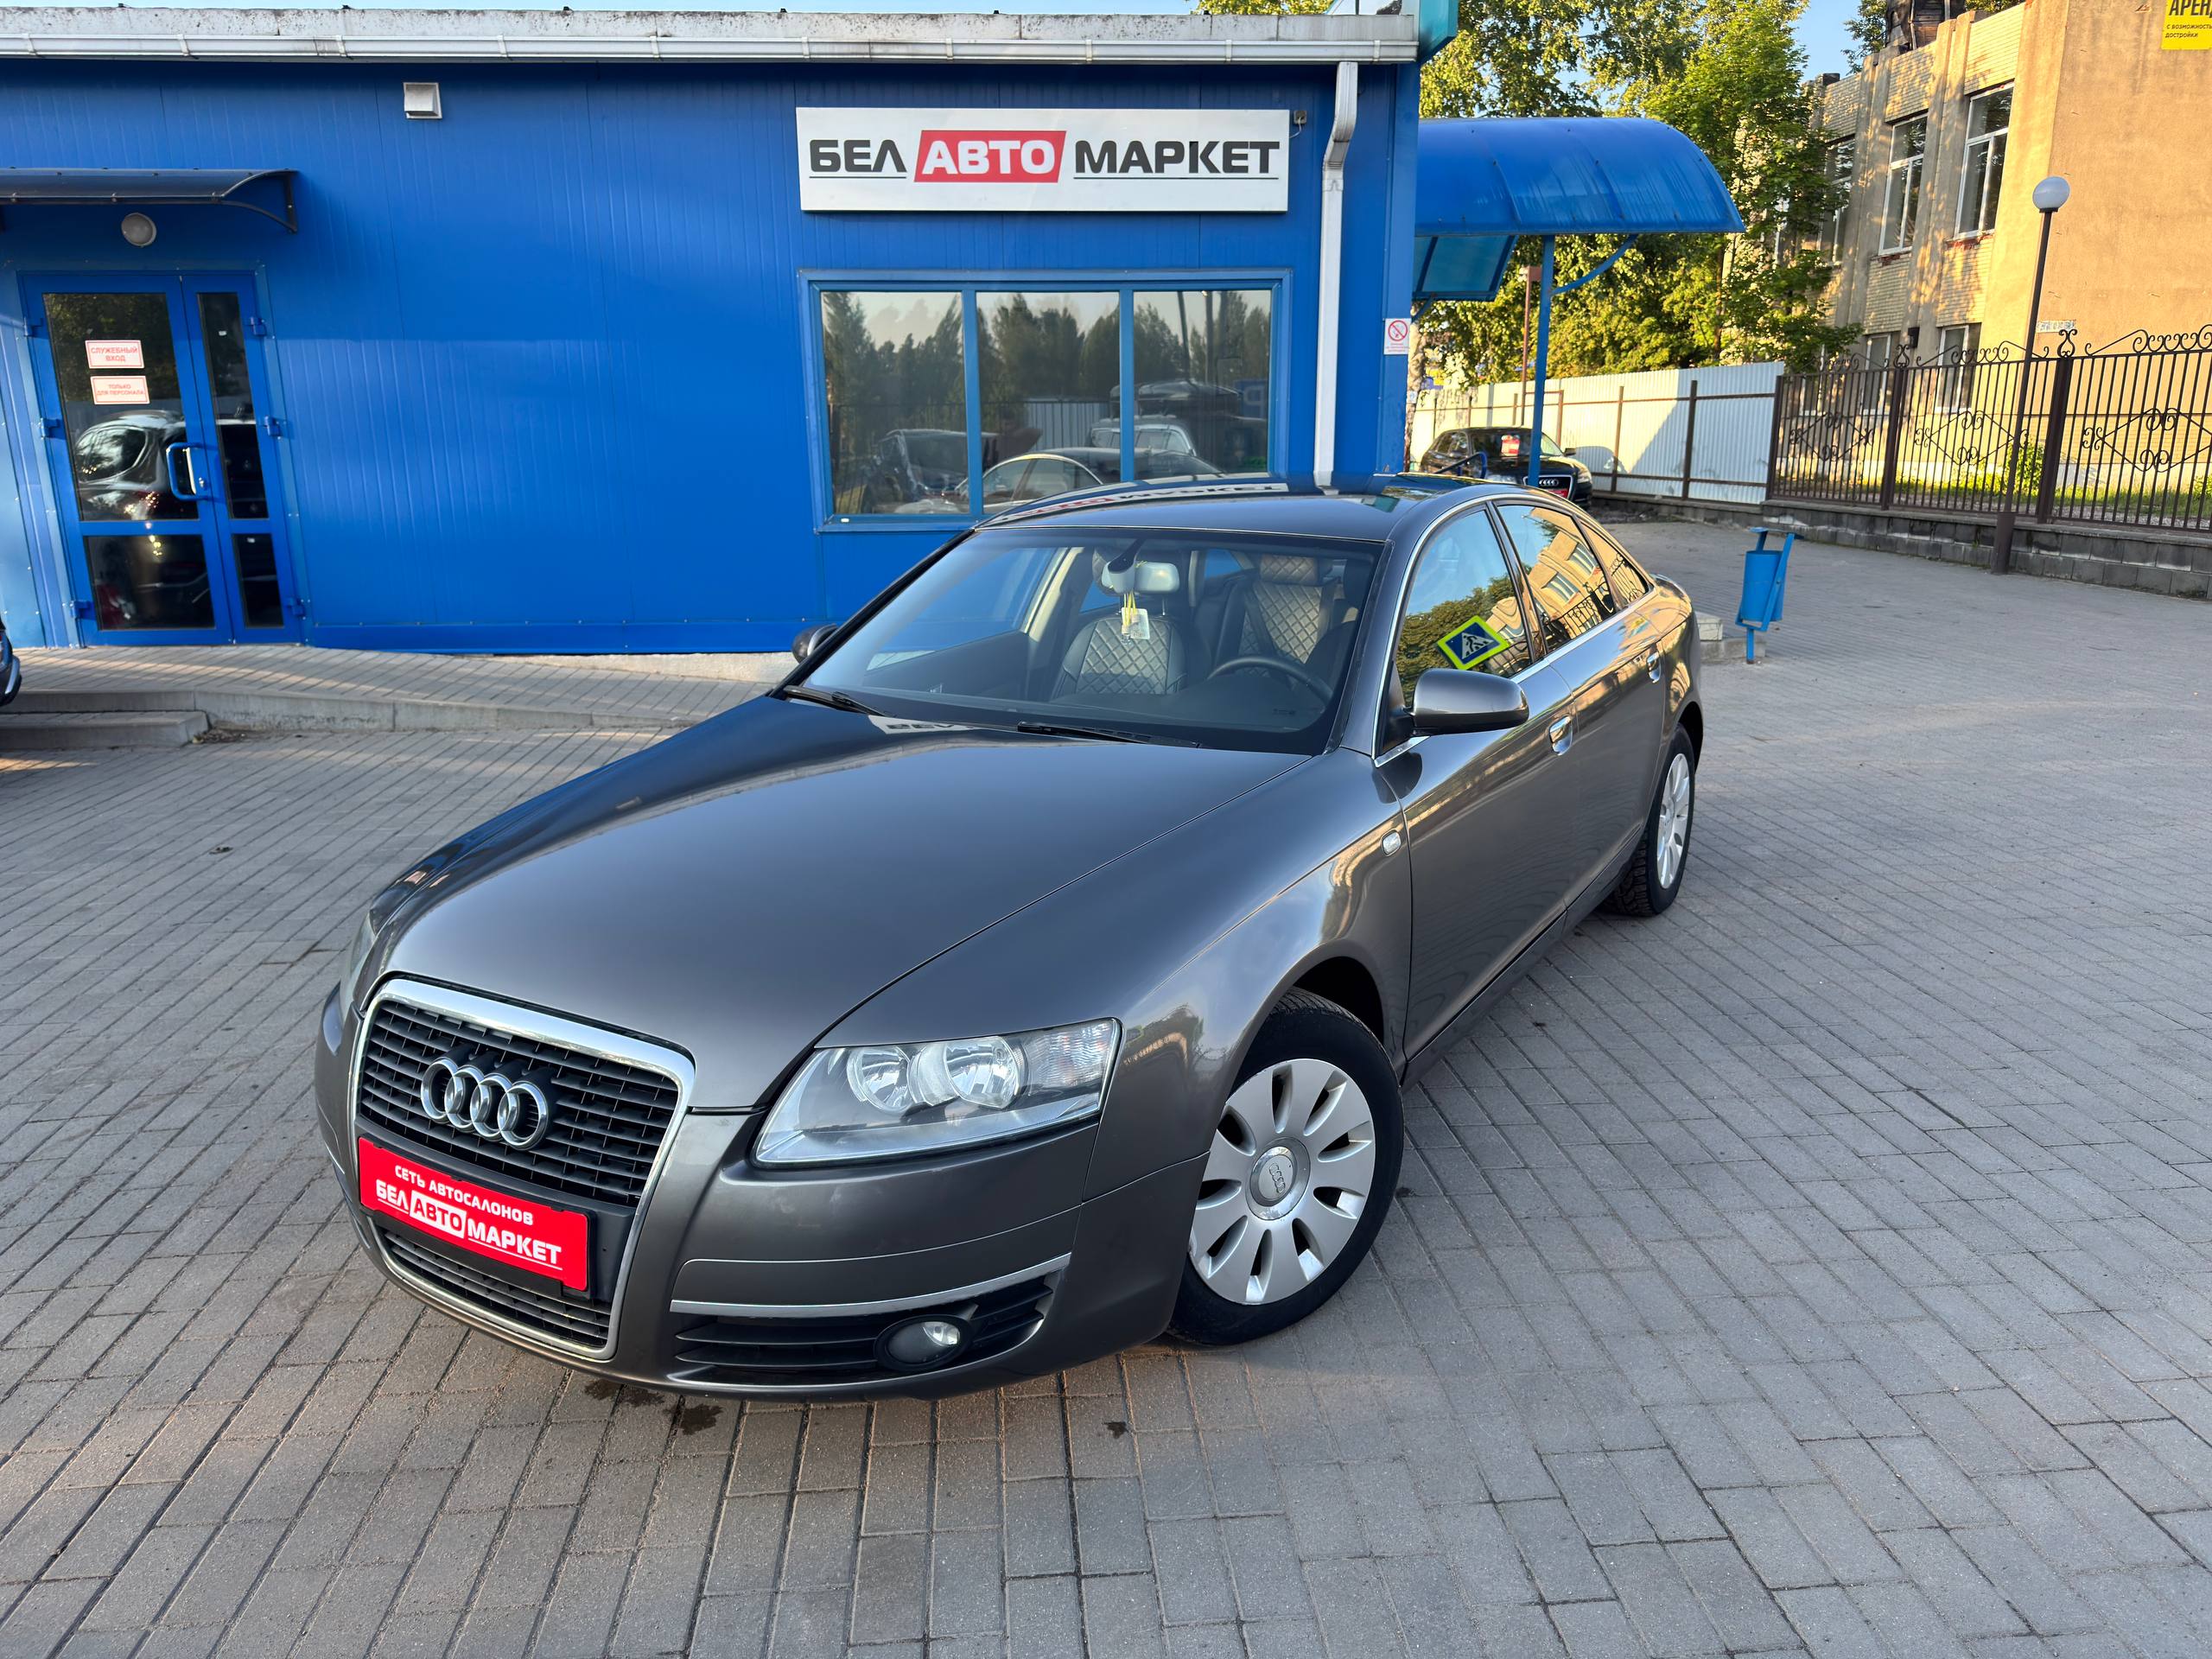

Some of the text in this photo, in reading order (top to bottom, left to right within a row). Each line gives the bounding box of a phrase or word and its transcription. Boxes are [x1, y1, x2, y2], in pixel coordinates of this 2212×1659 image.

[810, 139, 1281, 175] БЕЛ АВТО МАРКЕТ
[91, 346, 138, 354] СЛУЖЕБНЫЙ
[395, 1165, 534, 1225] СЕТЬ АВТОСАЛОНОВ
[376, 1179, 562, 1265] БЕЛ АВТО МАРКЕТ
